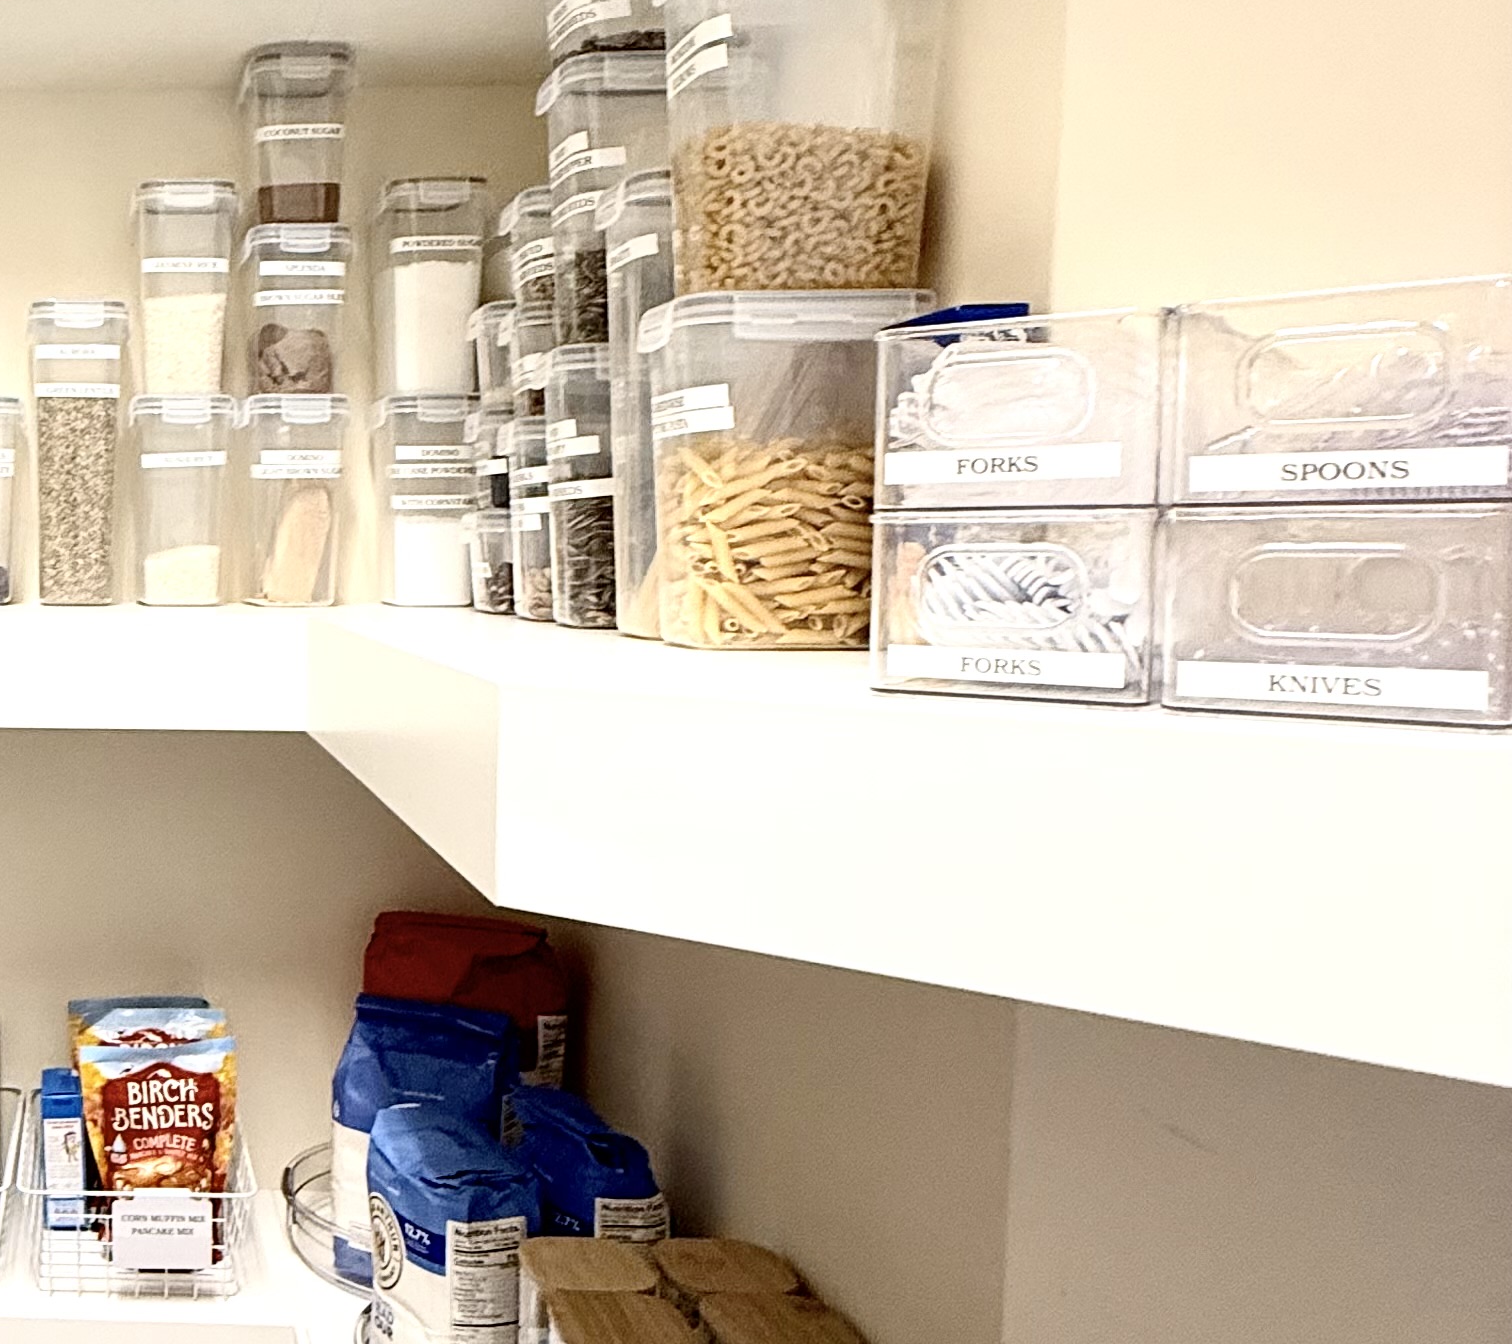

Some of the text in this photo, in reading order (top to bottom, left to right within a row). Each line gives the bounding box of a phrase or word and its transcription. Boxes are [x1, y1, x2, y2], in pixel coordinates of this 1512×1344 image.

[263, 127, 309, 137] COCONUT
[956, 455, 1039, 475] FORKS
[1280, 460, 1411, 482] SPOONS
[959, 656, 1042, 677] FORKS
[1267, 674, 1383, 697] KNIVES
[127, 1078, 199, 1106] BIRCH
[110, 1102, 215, 1132] BENDERS
[132, 1133, 198, 1152] COMPLETE
[151, 1215, 186, 1223] MUFFIN
[188, 1215, 206, 1223] MIX
[176, 1227, 194, 1235] MIX
